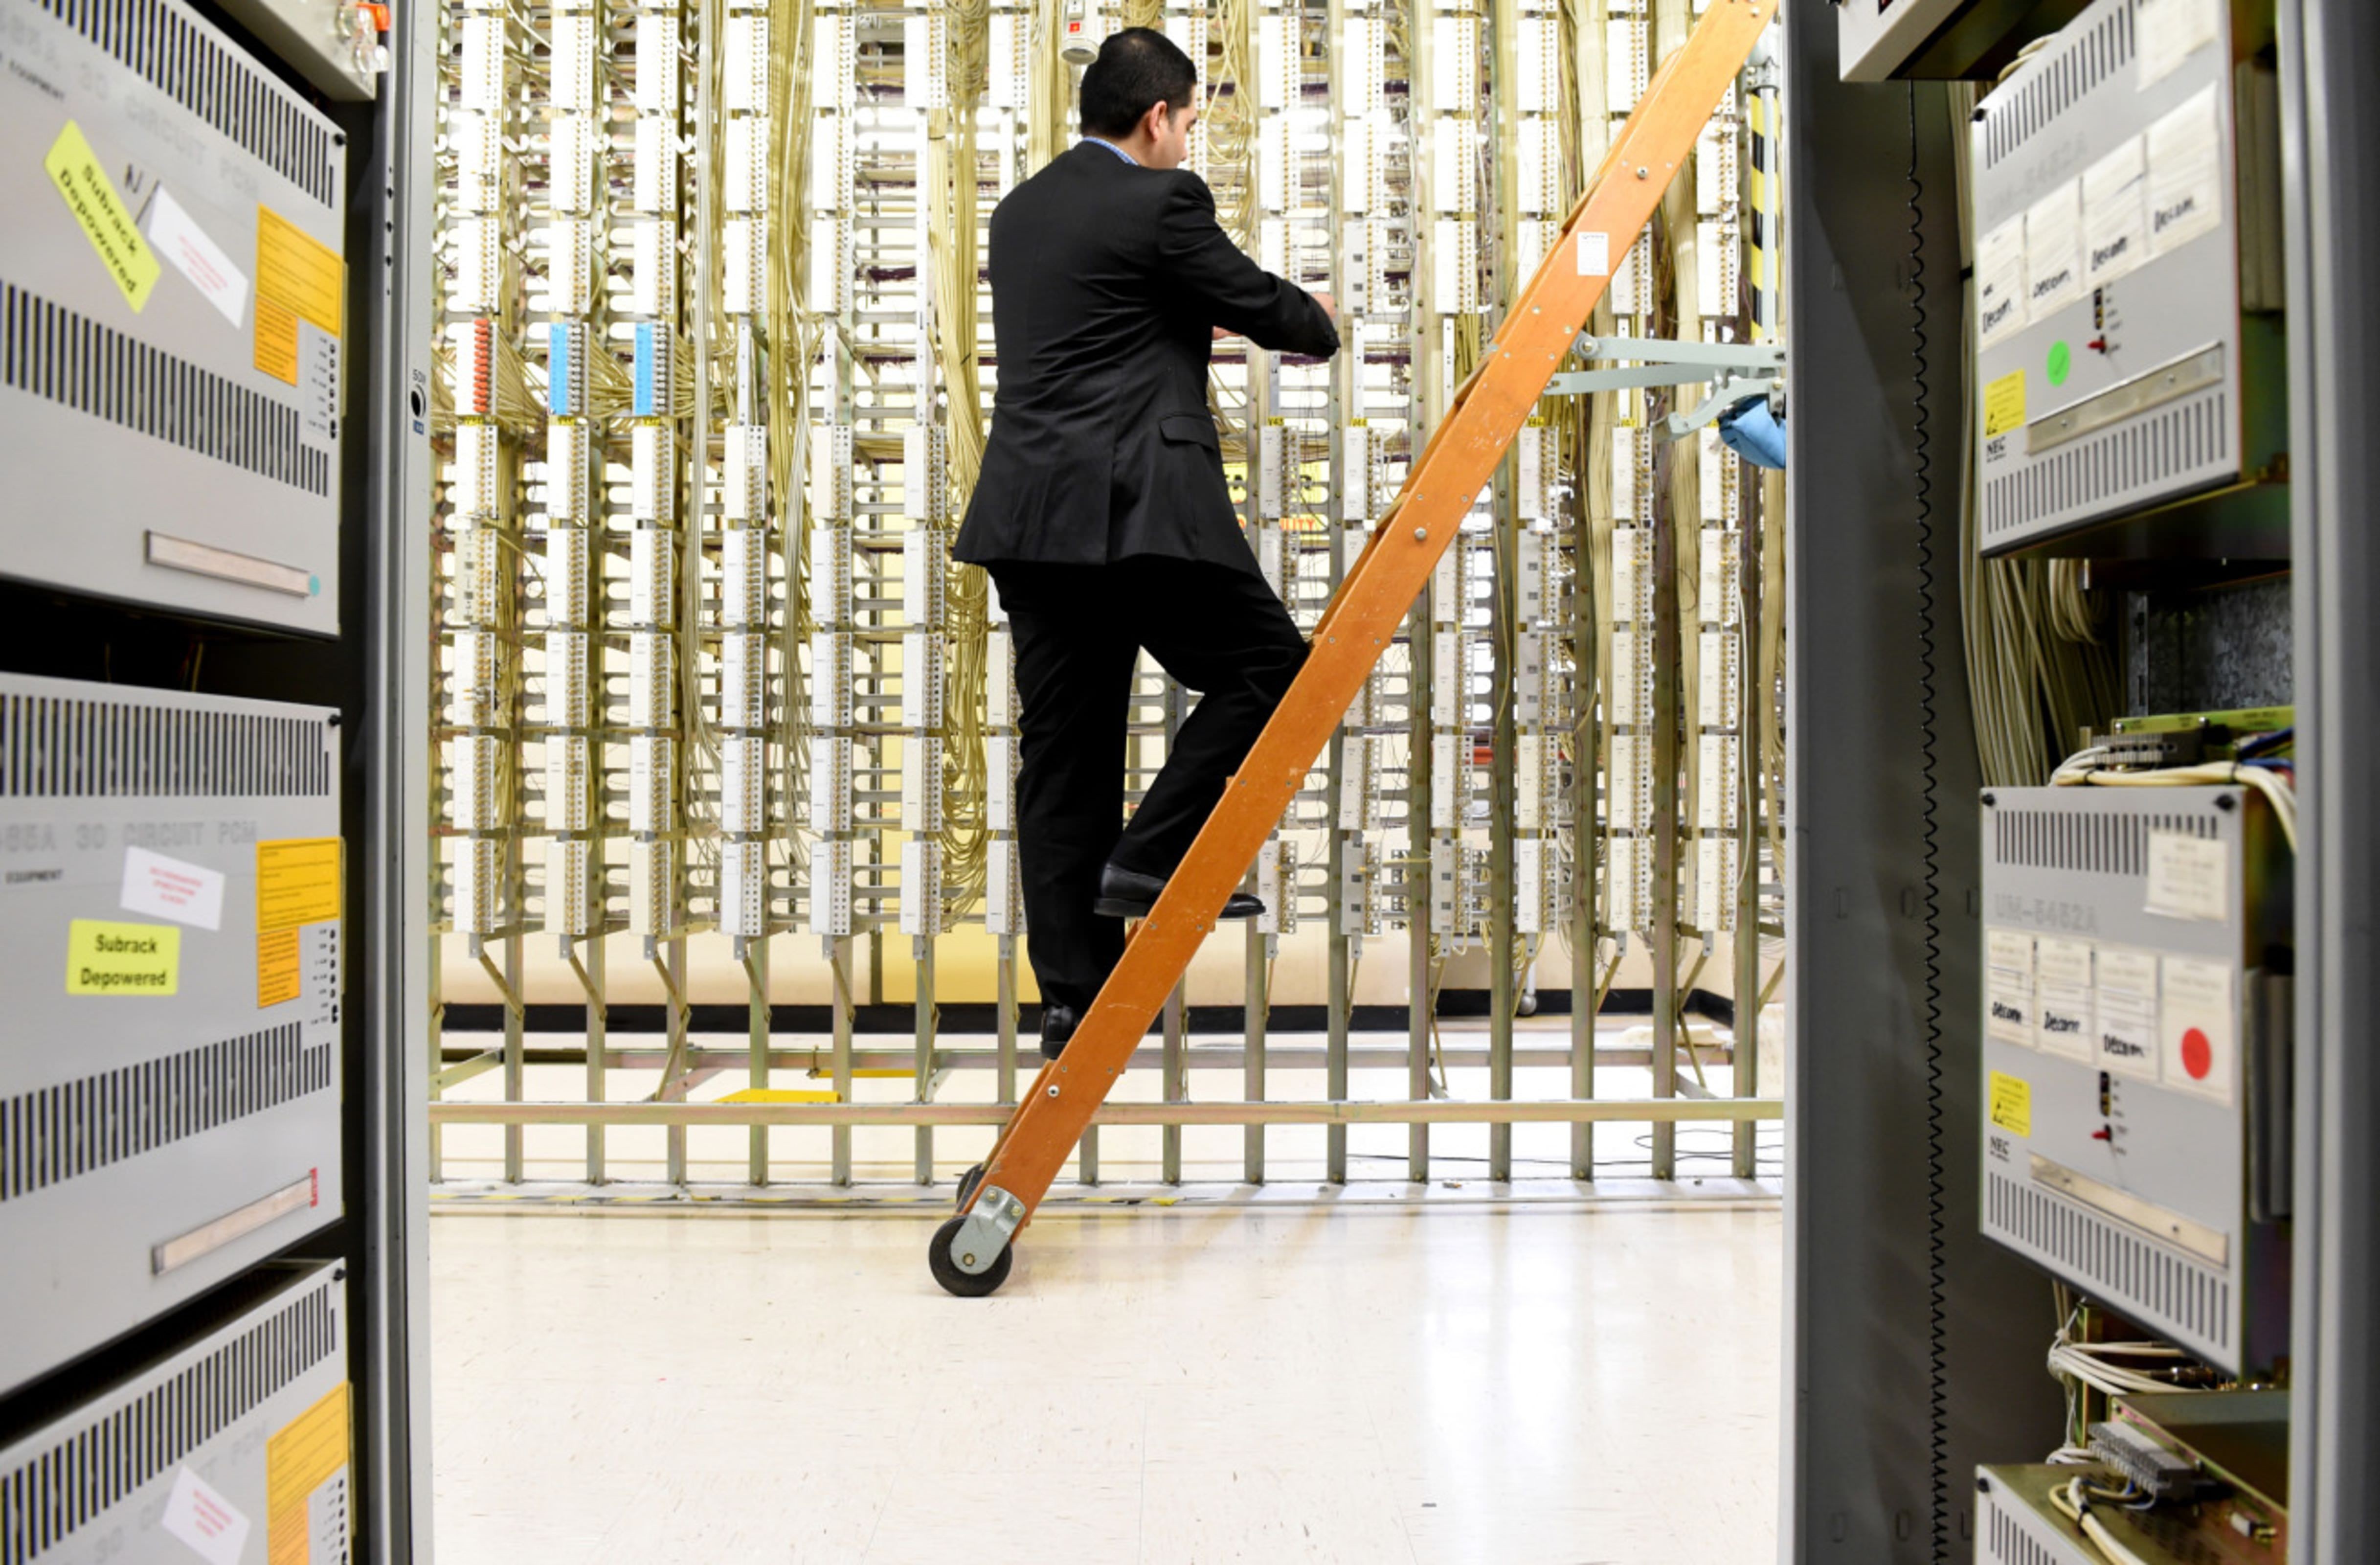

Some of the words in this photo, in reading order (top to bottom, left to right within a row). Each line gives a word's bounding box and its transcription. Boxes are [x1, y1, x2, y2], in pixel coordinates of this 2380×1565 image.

[81, 165, 139, 256] Subrack
[58, 168, 137, 295] Depowered
[123, 822, 204, 847] CIRCUIT
[6, 869, 63, 883] EQUIPMENT
[95, 933, 158, 954] Subrack
[81, 968, 167, 989] Depowered
